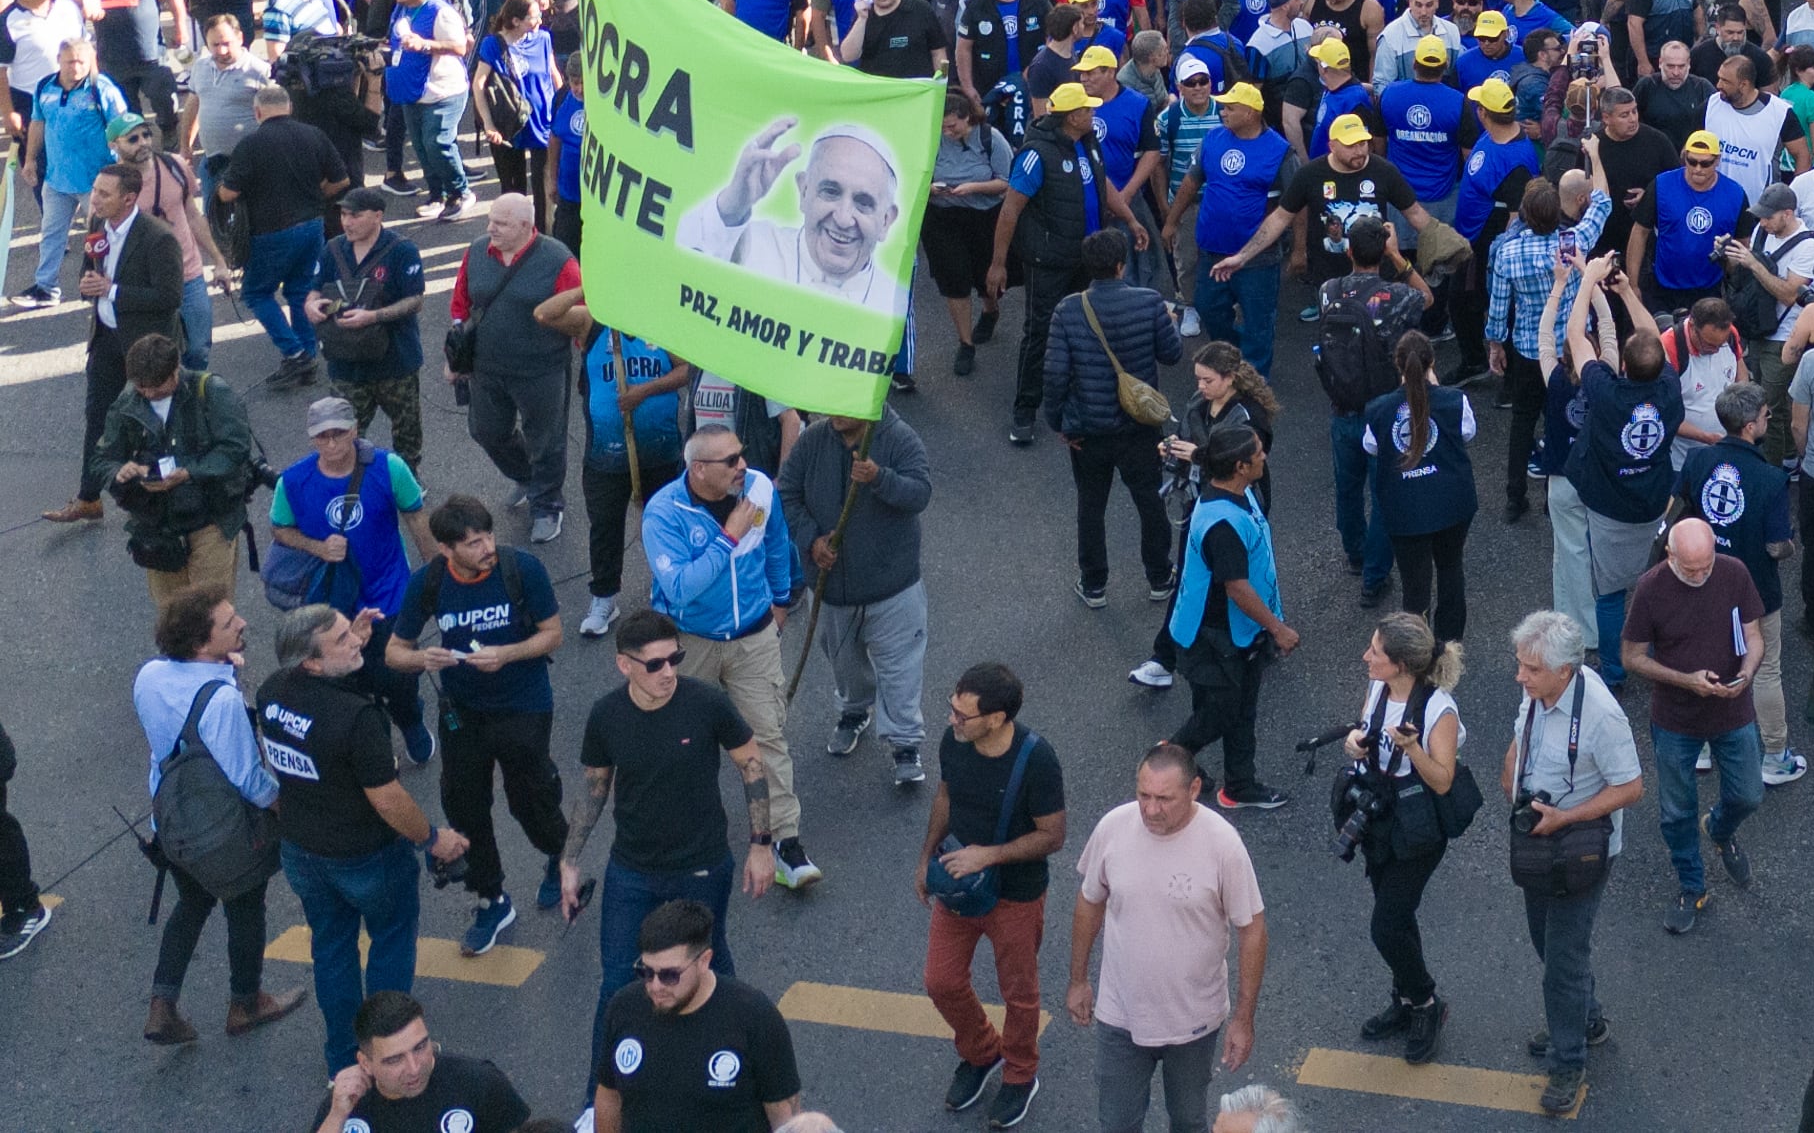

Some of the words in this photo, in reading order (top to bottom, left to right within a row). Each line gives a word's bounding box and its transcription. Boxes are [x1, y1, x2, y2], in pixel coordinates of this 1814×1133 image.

[680, 283, 722, 326] PAZ,
[727, 305, 791, 352] AMOR
[794, 329, 815, 357] Y
[1401, 465, 1438, 479] PRENSA
[458, 604, 511, 627] UPCN
[471, 618, 511, 633] FEDERAL
[278, 710, 312, 736] UPCN
[267, 744, 314, 777] PRENSA
